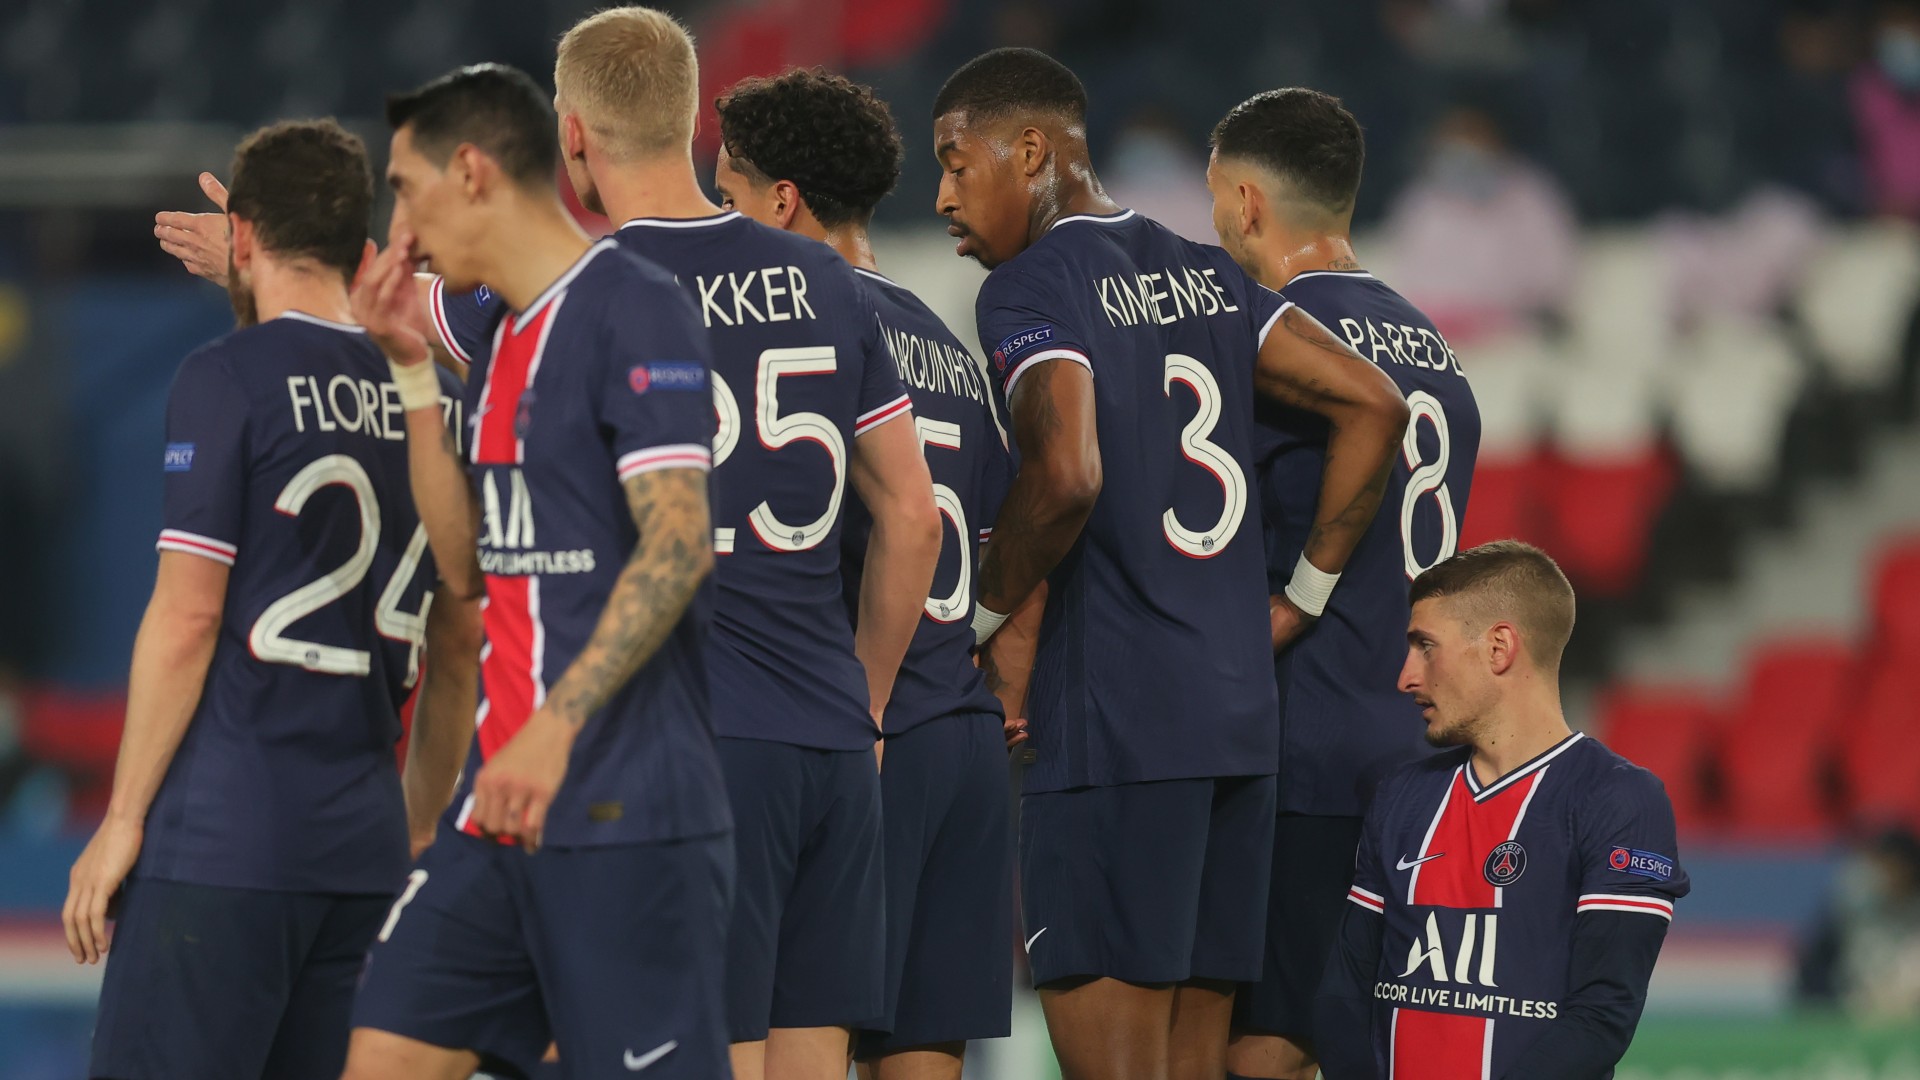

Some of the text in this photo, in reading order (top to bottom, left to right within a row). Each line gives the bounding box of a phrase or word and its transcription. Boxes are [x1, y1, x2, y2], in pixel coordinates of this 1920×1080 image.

[674, 265, 817, 328] KKER
[1093, 265, 1239, 328] KIMPEMBE
[1003, 329, 1051, 358] RESPECT
[287, 373, 463, 456] FLOREI
[1162, 354, 1248, 560] 3
[1401, 390, 1458, 583] 8
[914, 415, 971, 625] 5
[249, 454, 434, 689] 24
[1495, 844, 1522, 856] PARIS
[1631, 856, 1673, 877] RESPECT
[1411, 986, 1450, 1007] LIVE
[1454, 991, 1558, 1019] LIMITLESS
